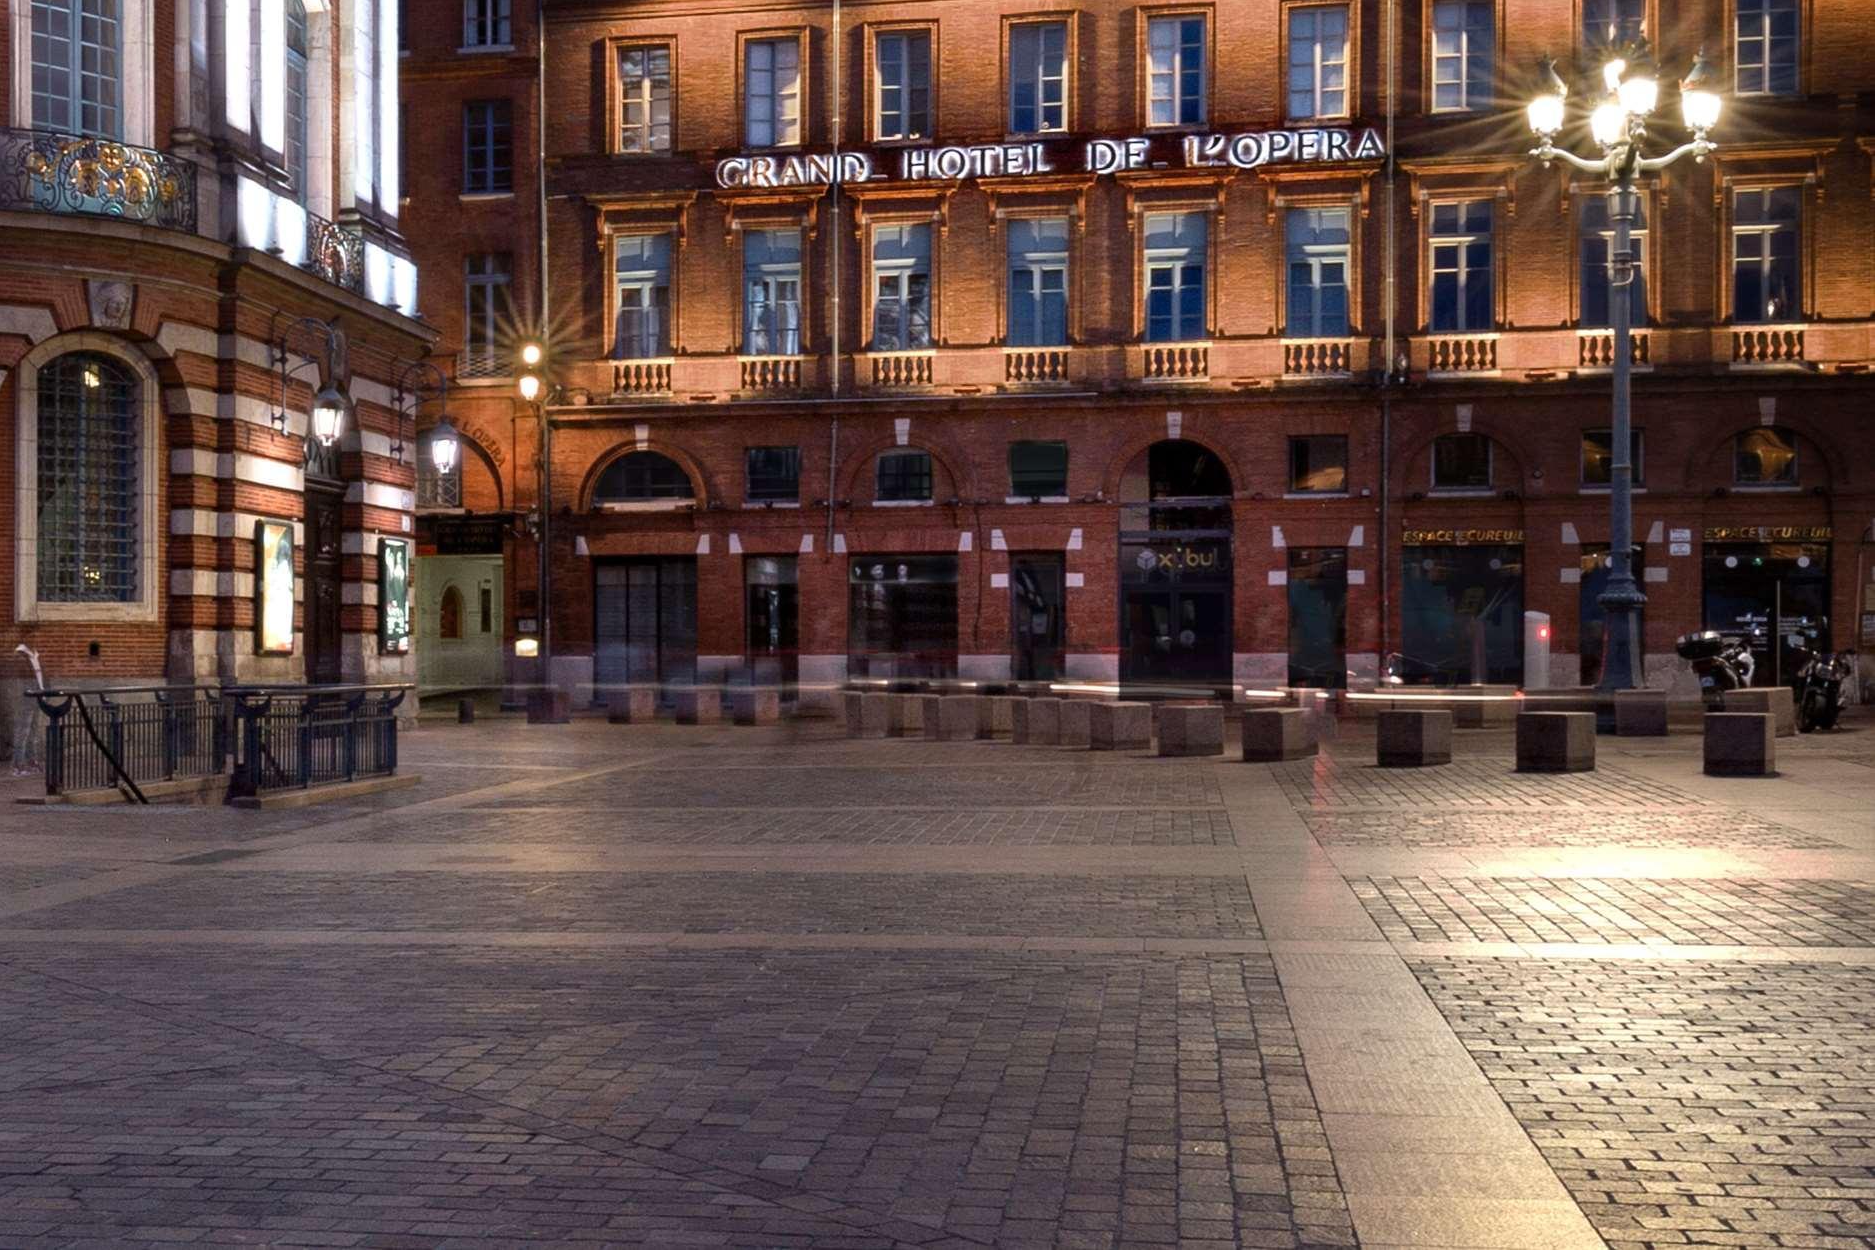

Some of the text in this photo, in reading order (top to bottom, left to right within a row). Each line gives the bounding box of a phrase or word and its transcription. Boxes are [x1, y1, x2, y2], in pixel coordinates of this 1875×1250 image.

[716, 128, 1383, 188] GRAND HOTEL DE L'OPERA
[1403, 530, 1454, 542] ESPACE
[1704, 526, 1756, 538] ESPACE
